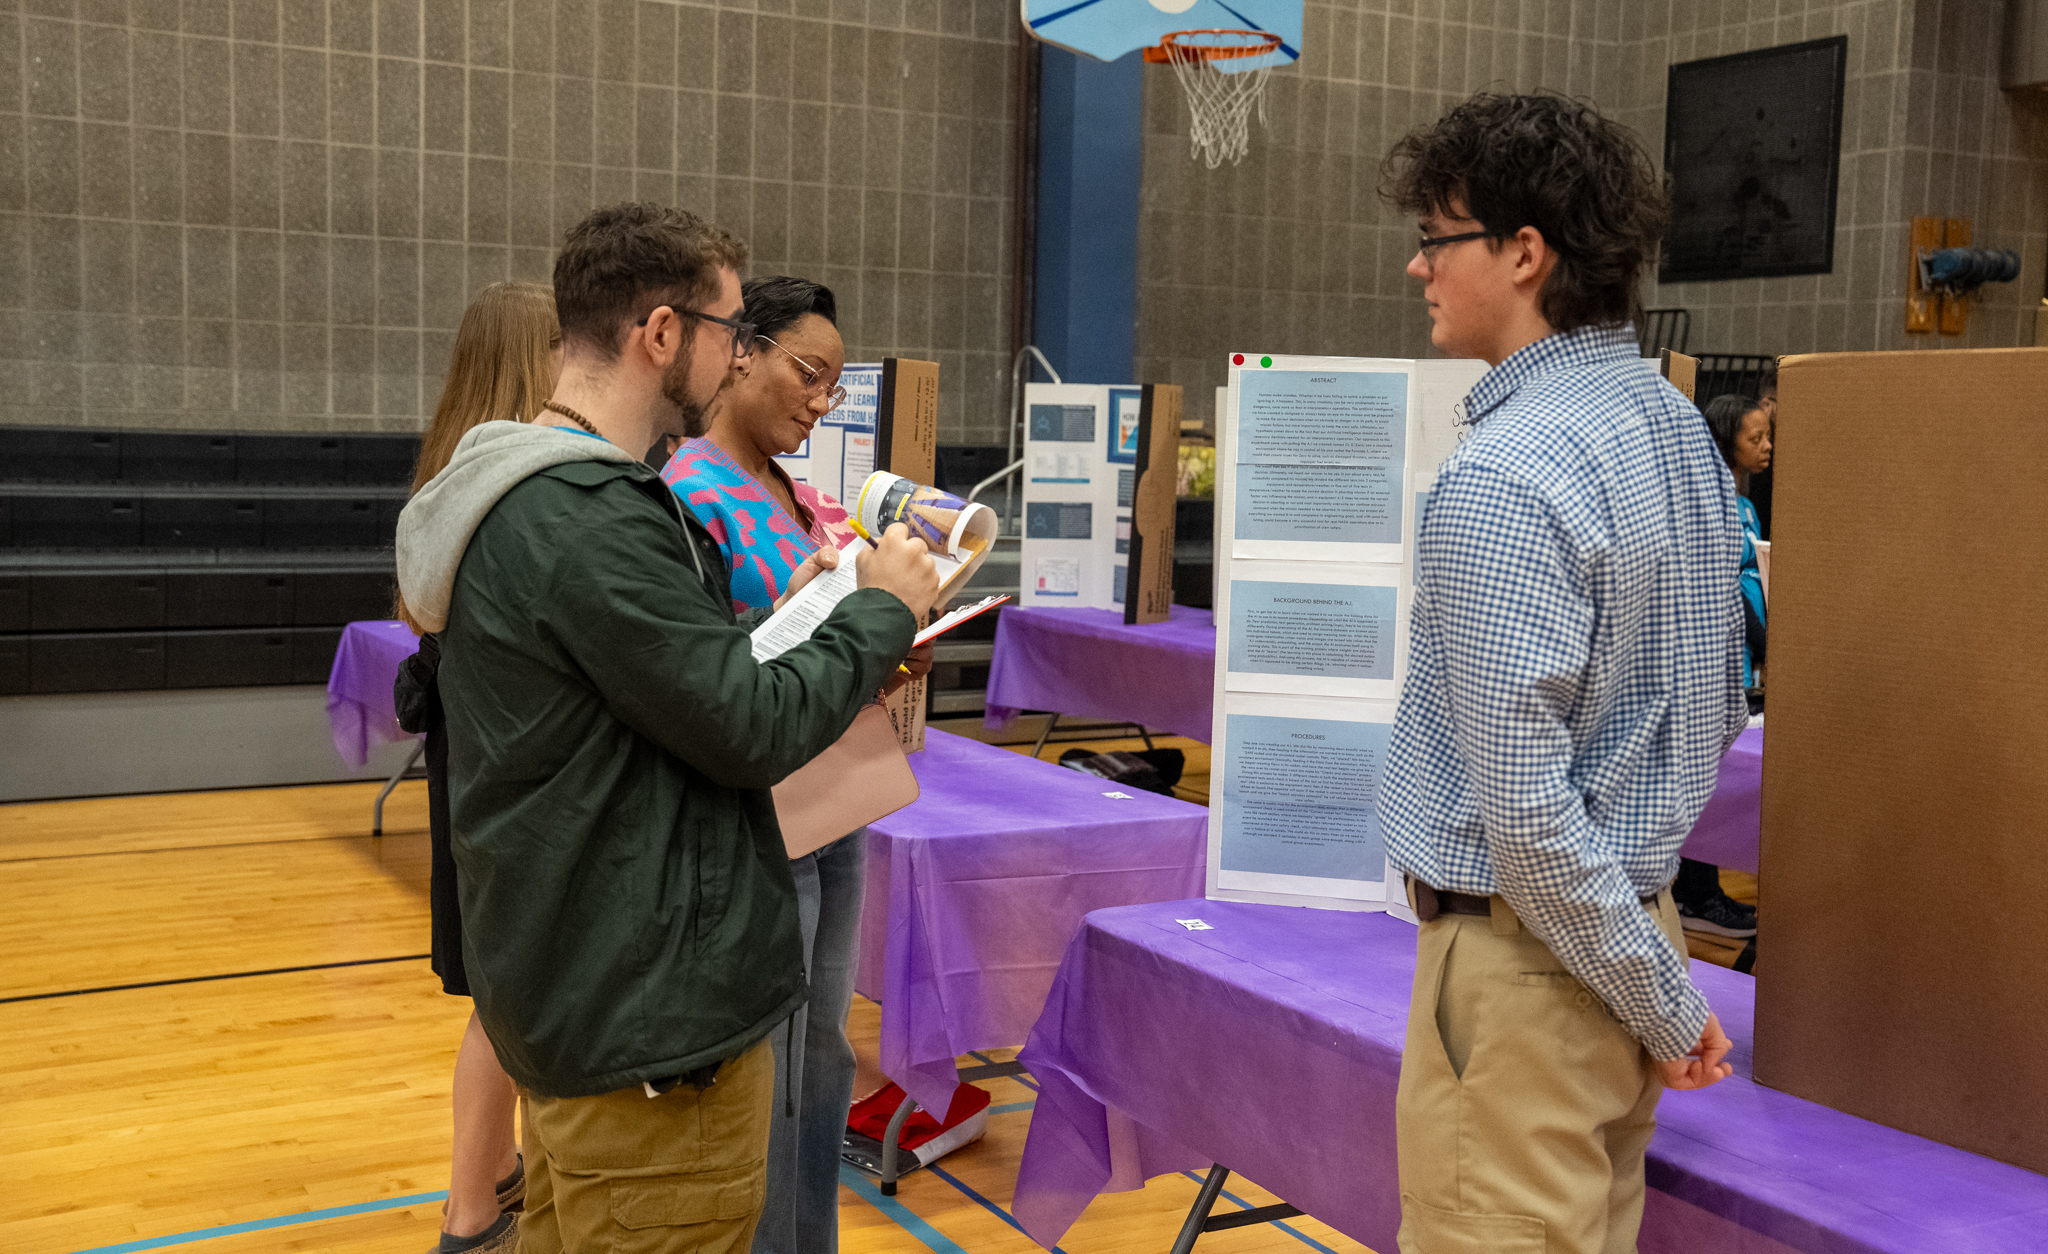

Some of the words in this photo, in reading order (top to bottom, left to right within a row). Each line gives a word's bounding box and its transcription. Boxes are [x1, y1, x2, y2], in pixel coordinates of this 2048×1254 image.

[839, 374, 874, 386] ARTIFICIAL
[847, 410, 866, 423] FROM
[1273, 597, 1312, 605] BACKGROUND
[1312, 598, 1332, 606] BEHIND
[1290, 733, 1326, 741] PROCEDURES
